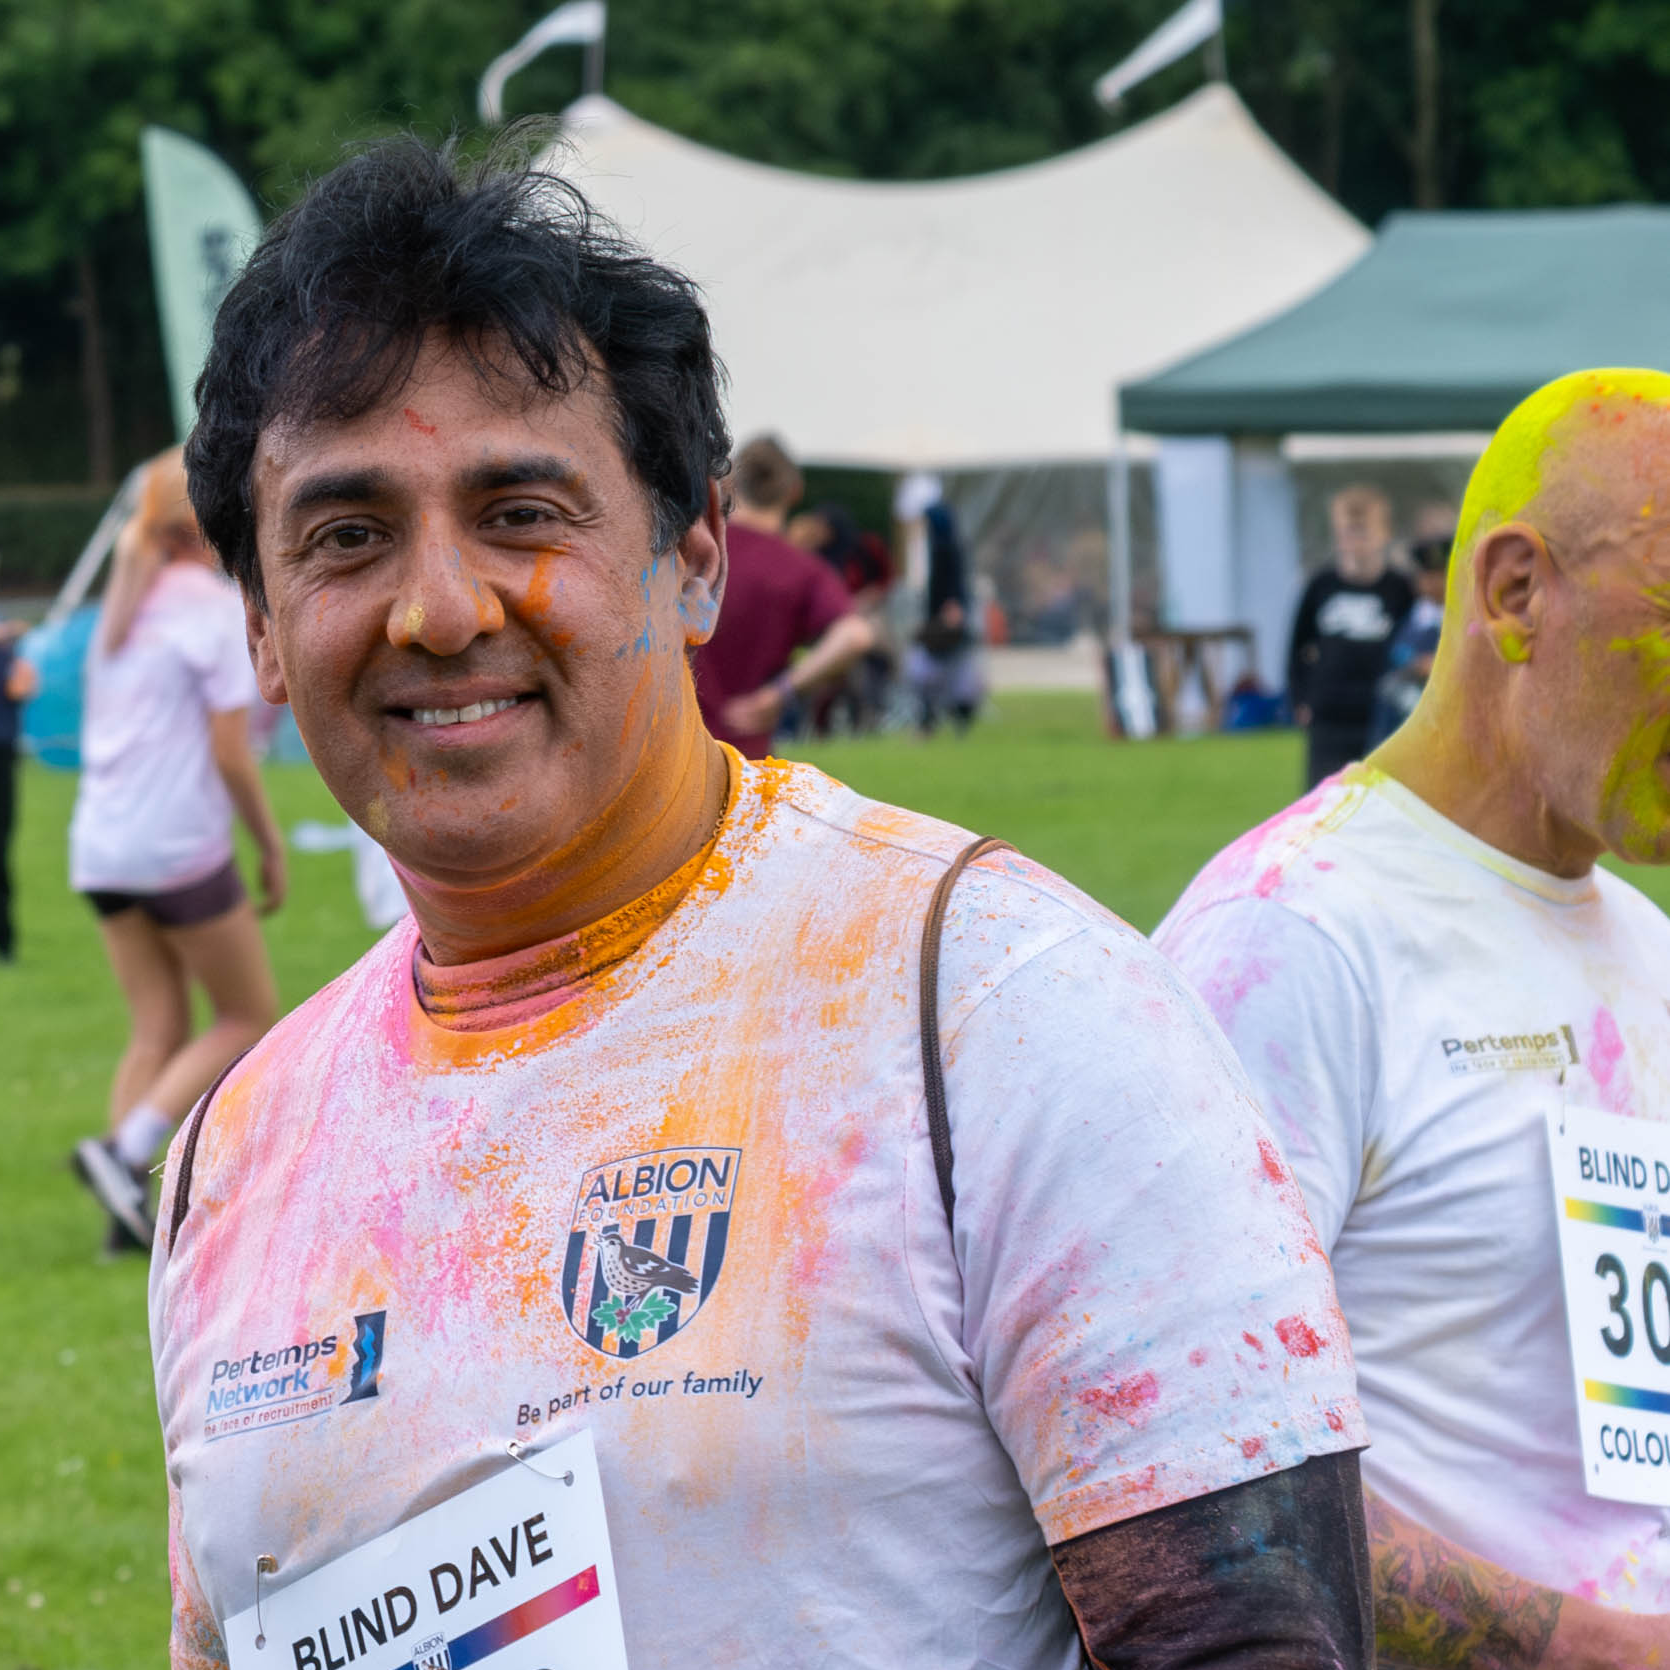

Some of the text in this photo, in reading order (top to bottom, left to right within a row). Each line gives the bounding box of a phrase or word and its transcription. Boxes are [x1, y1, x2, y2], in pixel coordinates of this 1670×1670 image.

[1441, 1031, 1559, 1058] Pertemps
[583, 1155, 731, 1206] ALBION
[1578, 1146, 1648, 1191] BLIND
[578, 1190, 727, 1224] FOUNDATION
[211, 1335, 337, 1386] Pertemps
[206, 1366, 309, 1415] Network
[259, 1394, 333, 1423] recruitment
[516, 1369, 763, 1426] Be part of our family
[1600, 1423, 1670, 1467] COLO
[429, 1512, 554, 1615] DAVE
[414, 1633, 444, 1656] ALBION
